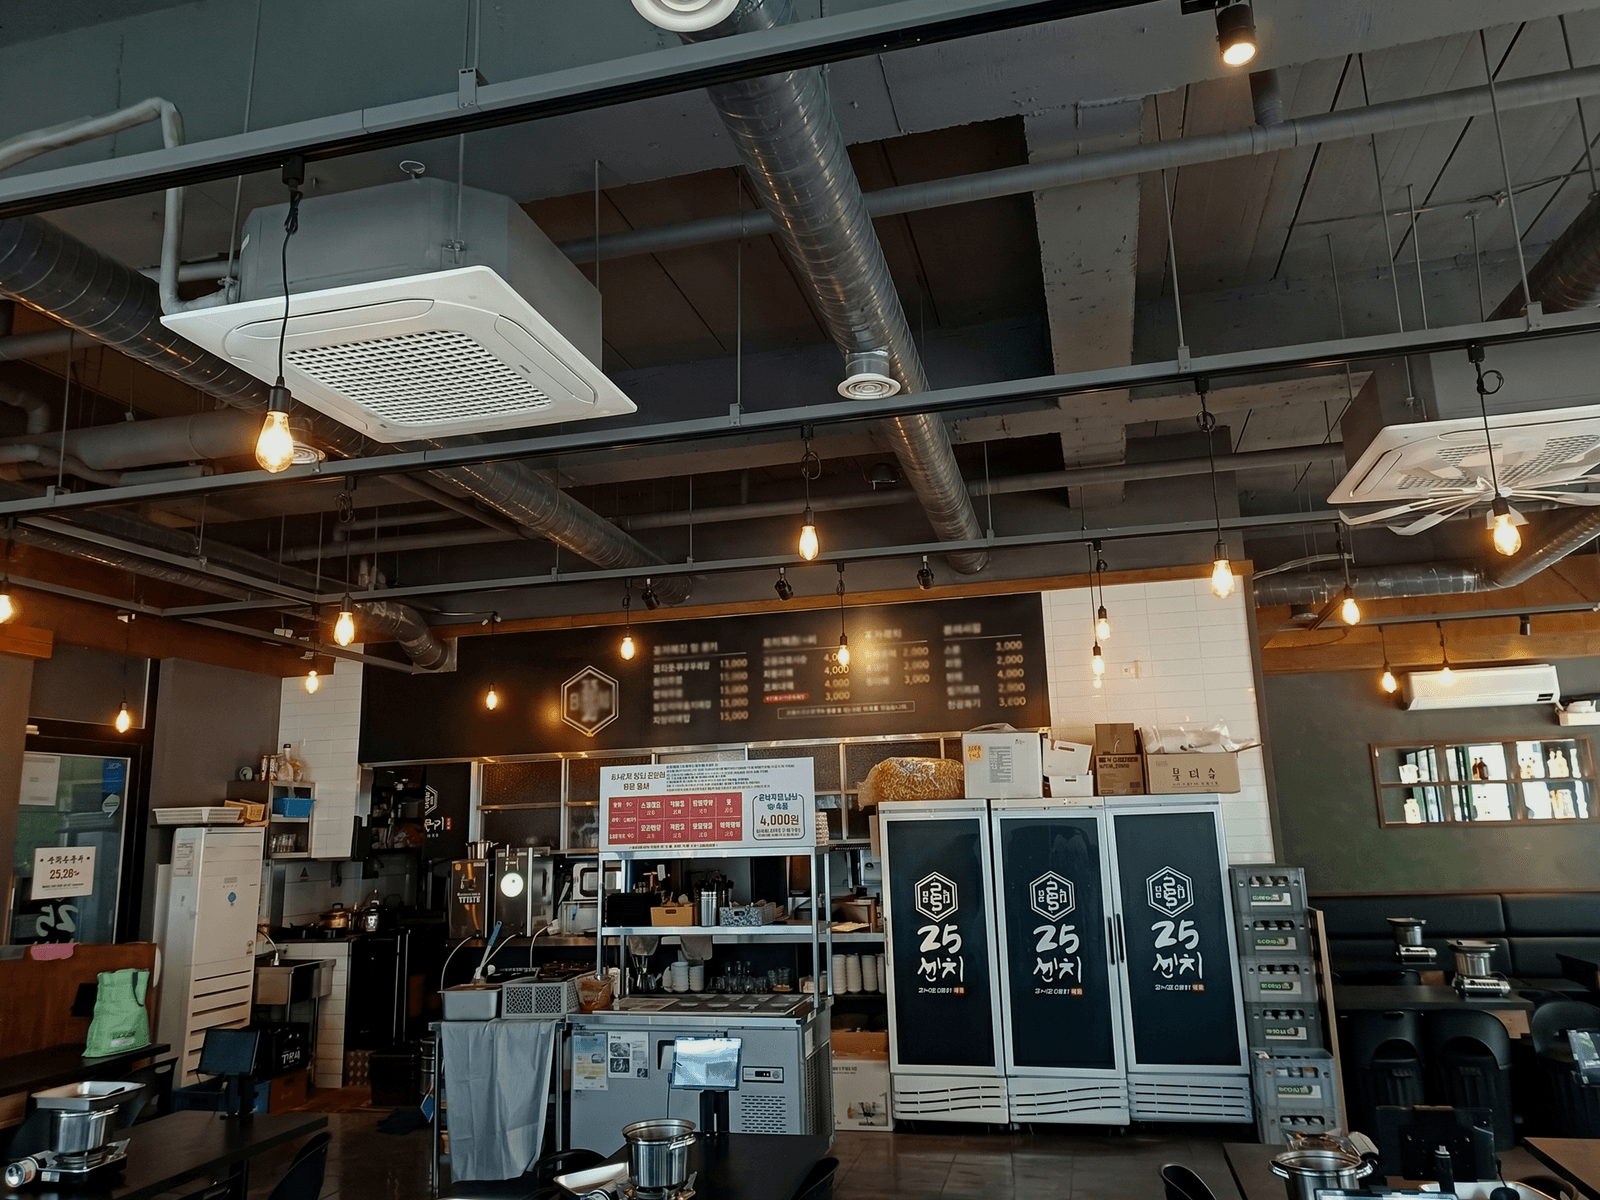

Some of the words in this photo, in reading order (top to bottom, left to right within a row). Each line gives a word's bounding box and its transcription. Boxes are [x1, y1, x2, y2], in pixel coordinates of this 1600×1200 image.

[824, 666, 850, 676] 4,000
[760, 813, 799, 827] 4,000원
[917, 923, 962, 954] 25
[1032, 923, 1080, 954] 25
[1151, 919, 1200, 950] 25
